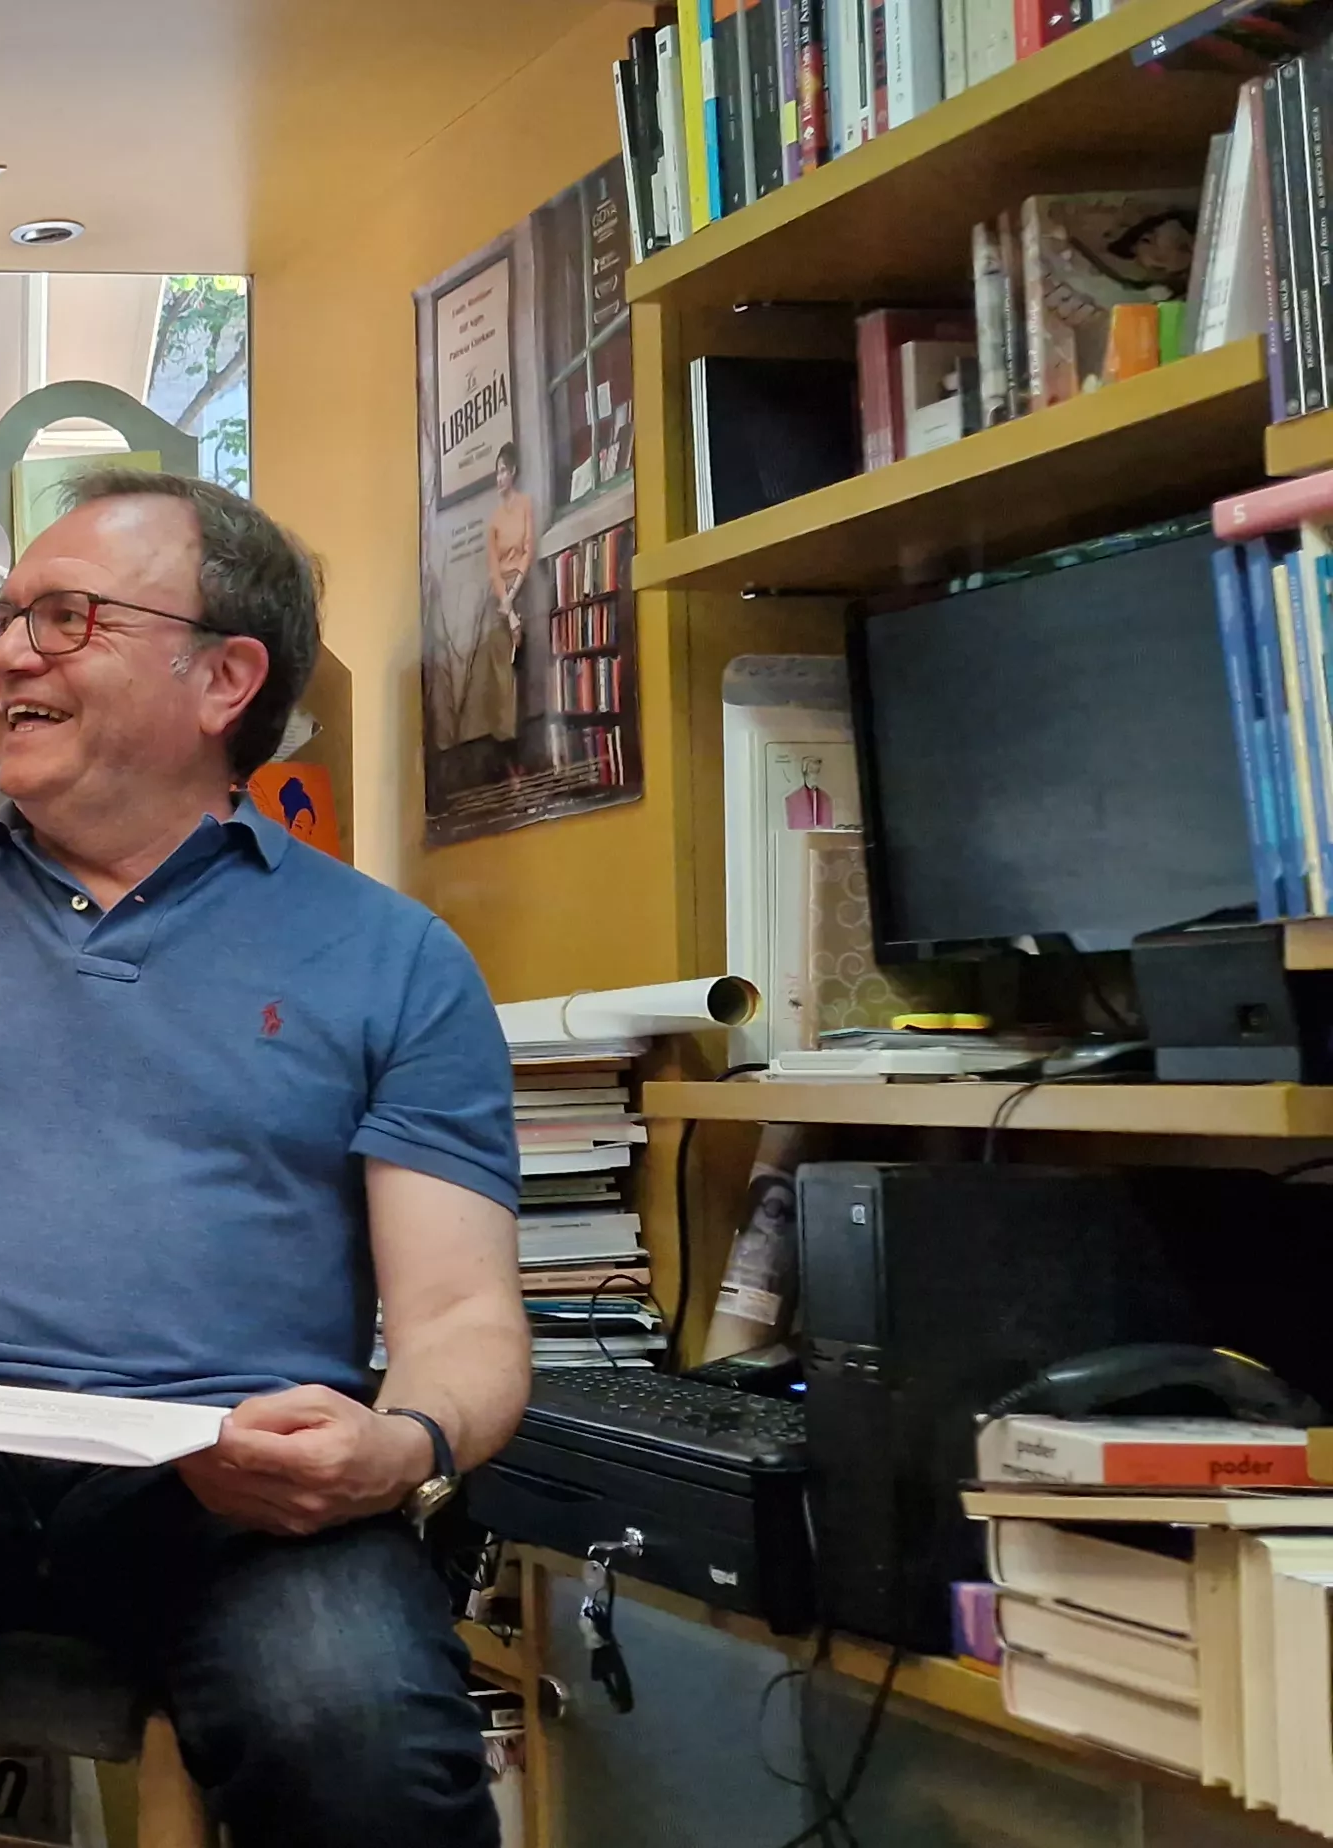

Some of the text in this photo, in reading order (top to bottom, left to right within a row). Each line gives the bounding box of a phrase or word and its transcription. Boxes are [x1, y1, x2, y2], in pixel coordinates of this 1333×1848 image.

[441, 368, 509, 456] LIBRERÍA
[1233, 504, 1246, 525] 5
[1015, 1437, 1057, 1460] poder
[1207, 1452, 1274, 1484] poder
